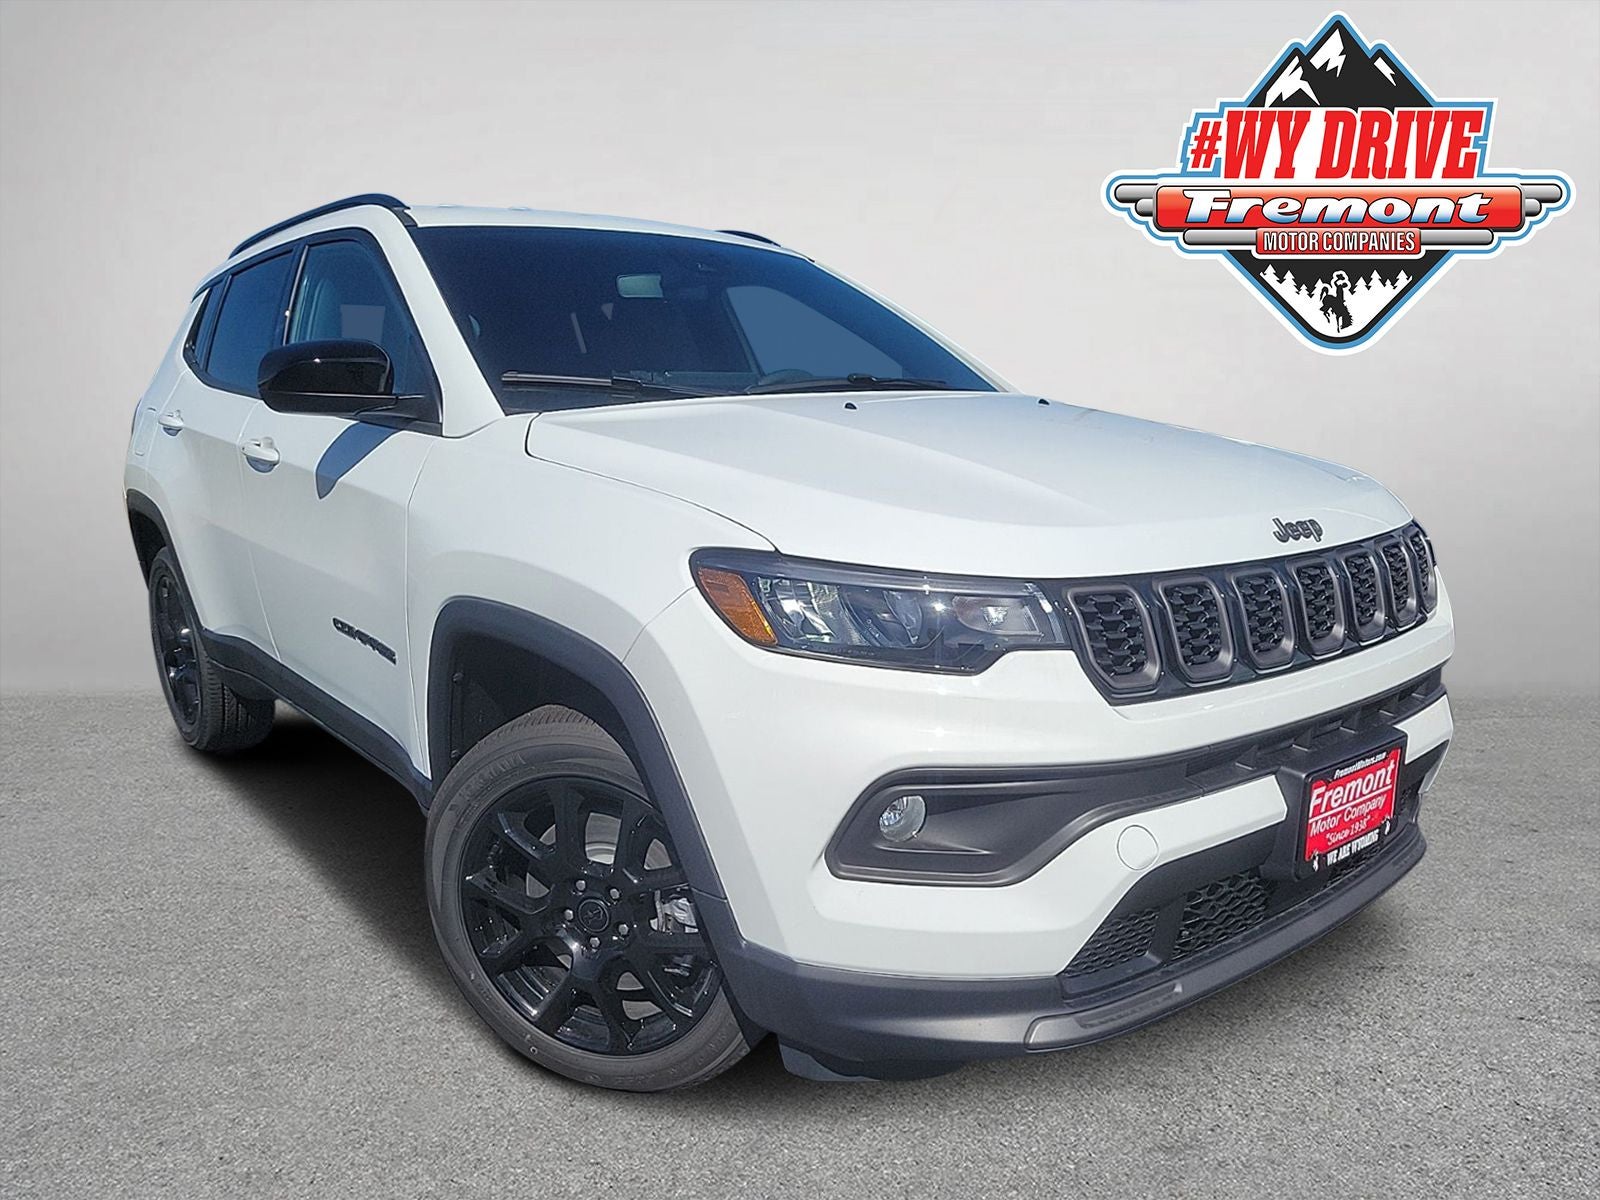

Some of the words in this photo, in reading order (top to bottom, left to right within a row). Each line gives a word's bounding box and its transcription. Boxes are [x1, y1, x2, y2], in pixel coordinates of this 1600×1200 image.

[1272, 517, 1323, 543] Jeep
[1309, 760, 1395, 818] Fremont
[1310, 814, 1342, 837] Motor
[1344, 794, 1387, 822] Company
